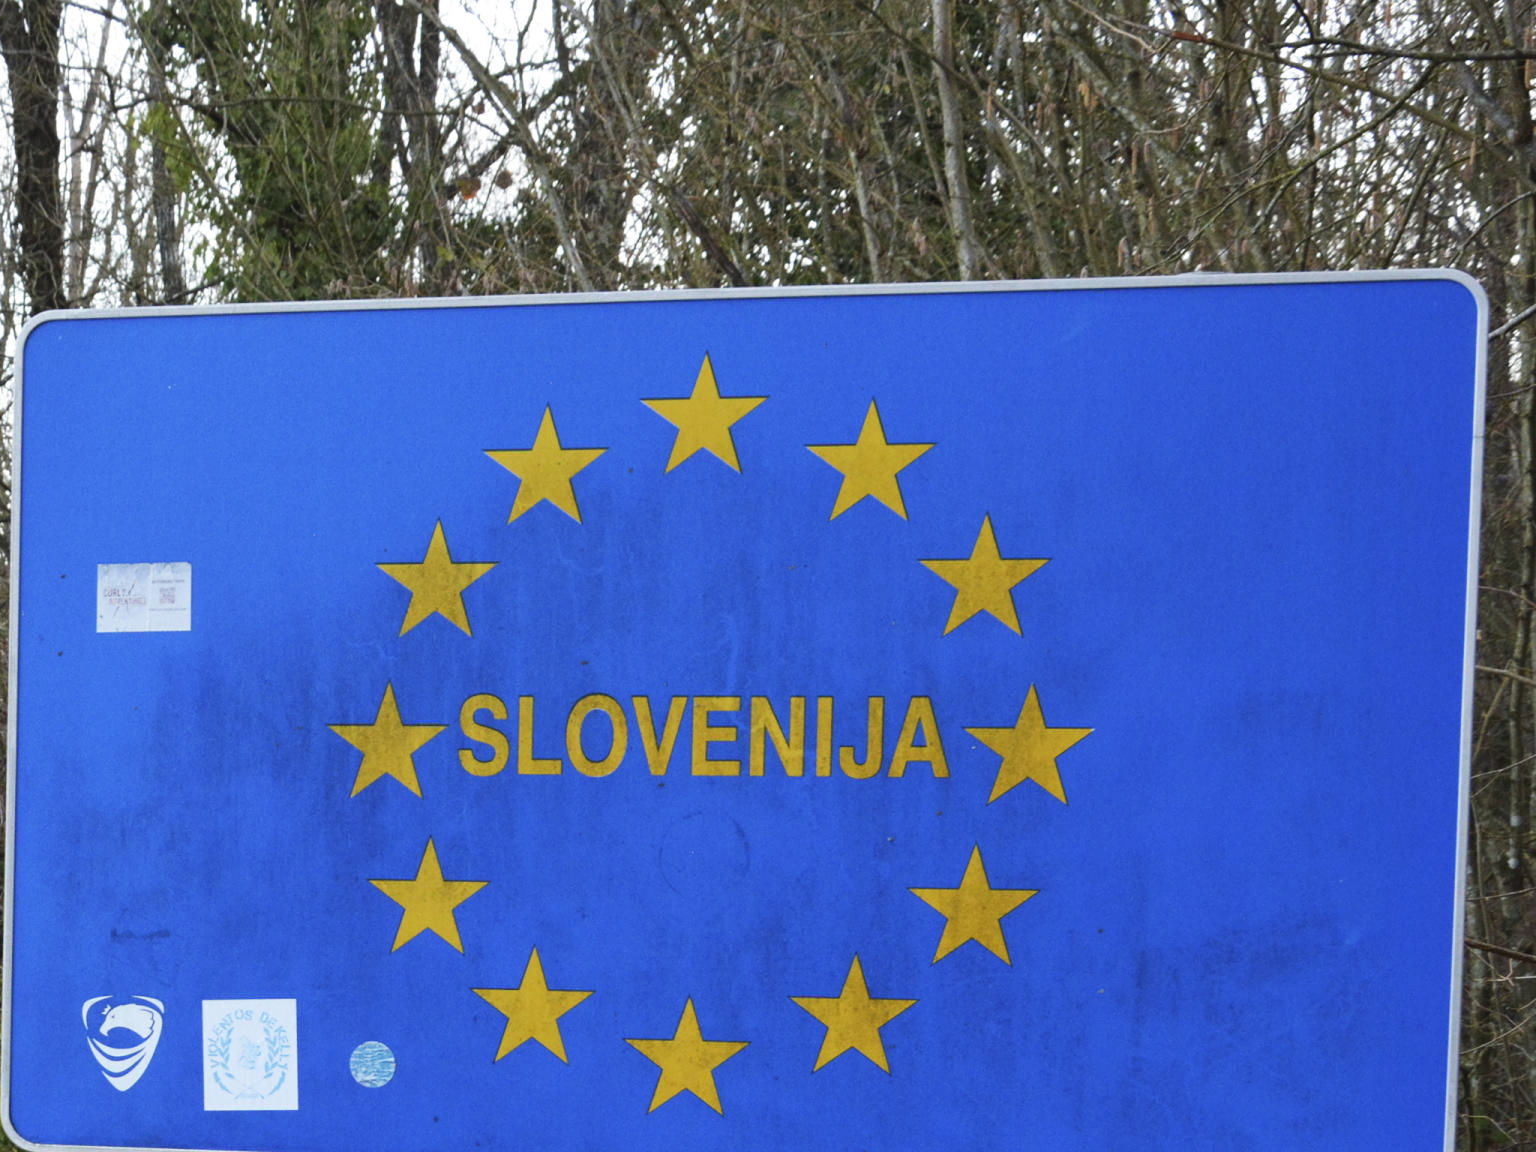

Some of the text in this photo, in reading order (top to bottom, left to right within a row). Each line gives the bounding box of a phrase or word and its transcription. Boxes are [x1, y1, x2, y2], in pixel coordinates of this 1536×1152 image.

[458, 693, 950, 779] SLOVENIJA
[208, 1009, 291, 1070] VIOLENTOS DE KELLY
